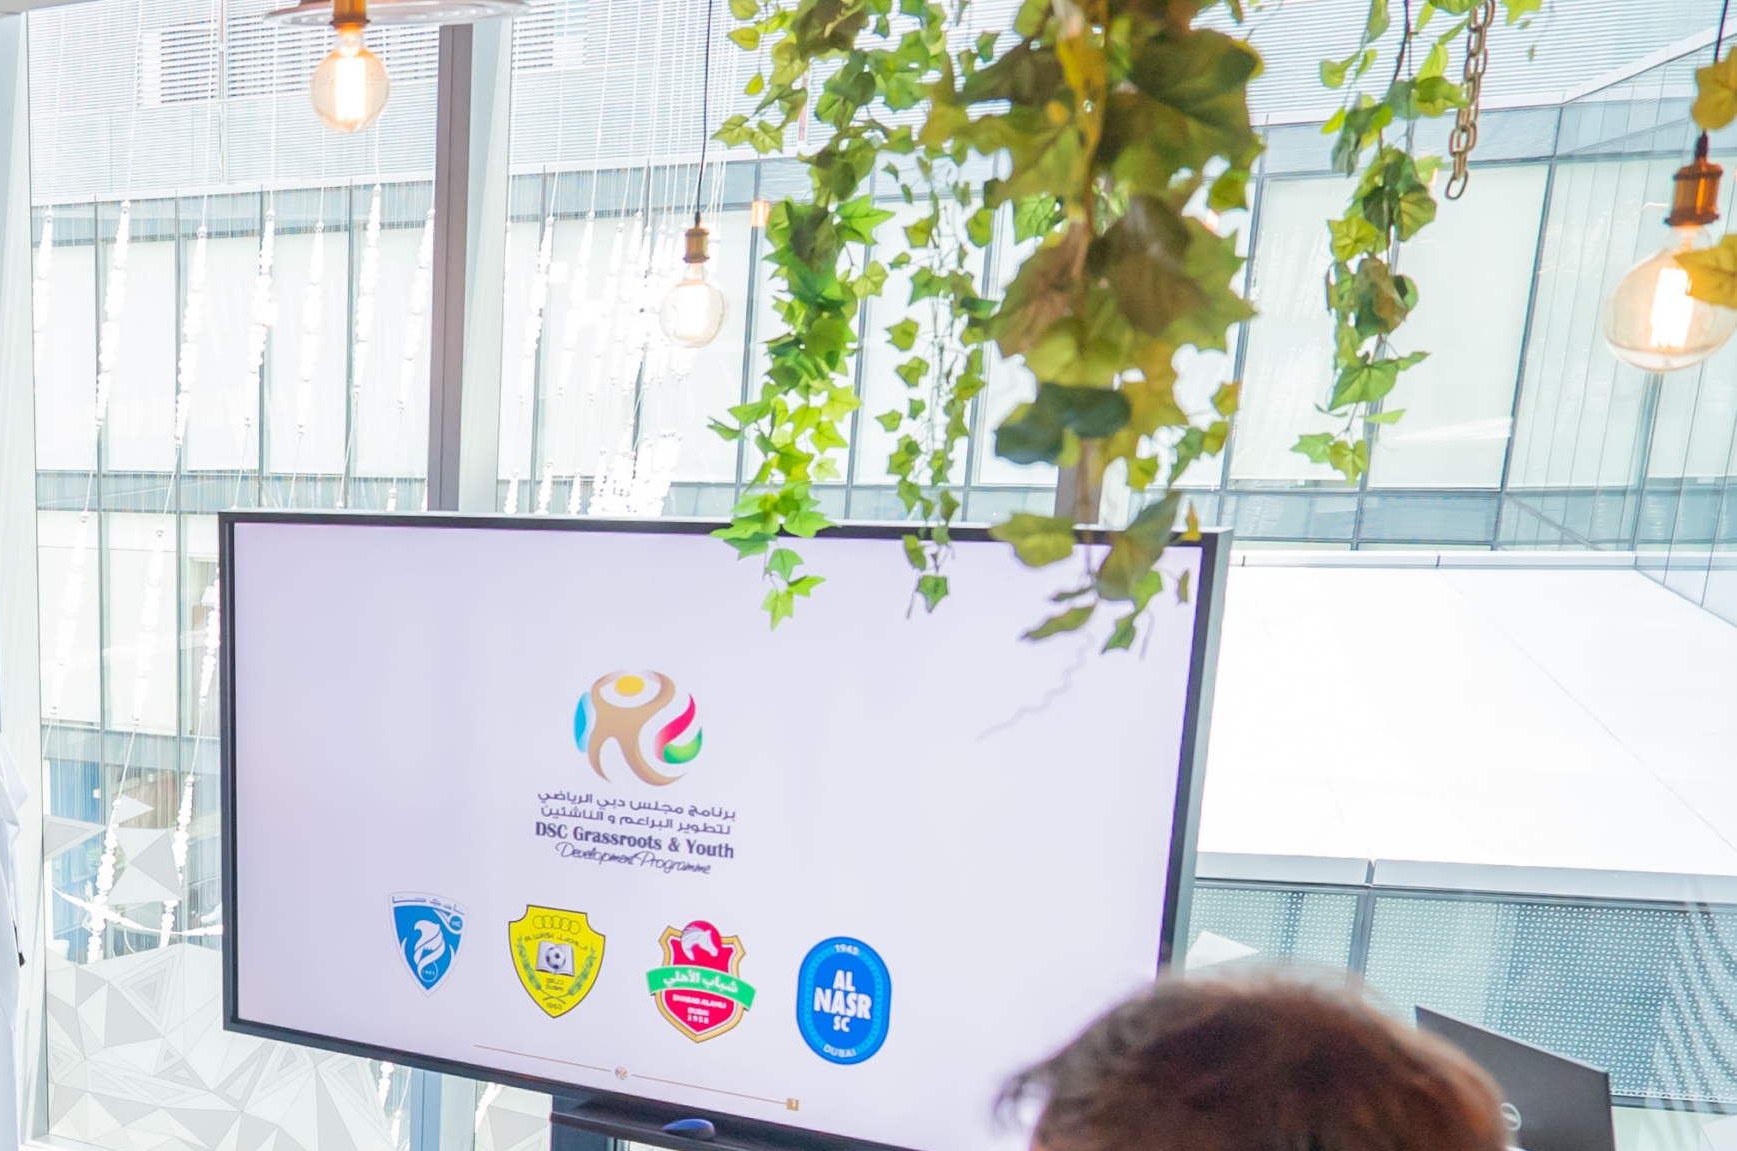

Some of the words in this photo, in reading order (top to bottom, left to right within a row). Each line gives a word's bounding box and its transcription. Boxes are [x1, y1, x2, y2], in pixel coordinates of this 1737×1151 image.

[537, 790, 593, 804] الرياضي
[596, 798, 626, 810] دبي
[541, 805, 604, 821] الناشئين
[630, 800, 684, 814] مجلس
[688, 805, 736, 822] برنامج
[607, 814, 616, 824] و
[619, 815, 673, 831] البراعم
[677, 822, 731, 835] لتطوير
[535, 821, 568, 839] DSC
[573, 826, 662, 850] Grassroots
[668, 837, 681, 852] &
[685, 838, 734, 859] Youth
[555, 841, 636, 865] Development
[634, 850, 712, 875] Programme
[834, 943, 860, 956] 1945
[663, 969, 700, 988] الأهلي
[702, 975, 739, 993] شباب
[832, 969, 856, 992] AL
[813, 987, 873, 1020] NASR
[832, 1016, 851, 1033] SC
[823, 1043, 858, 1059] DUBAI
